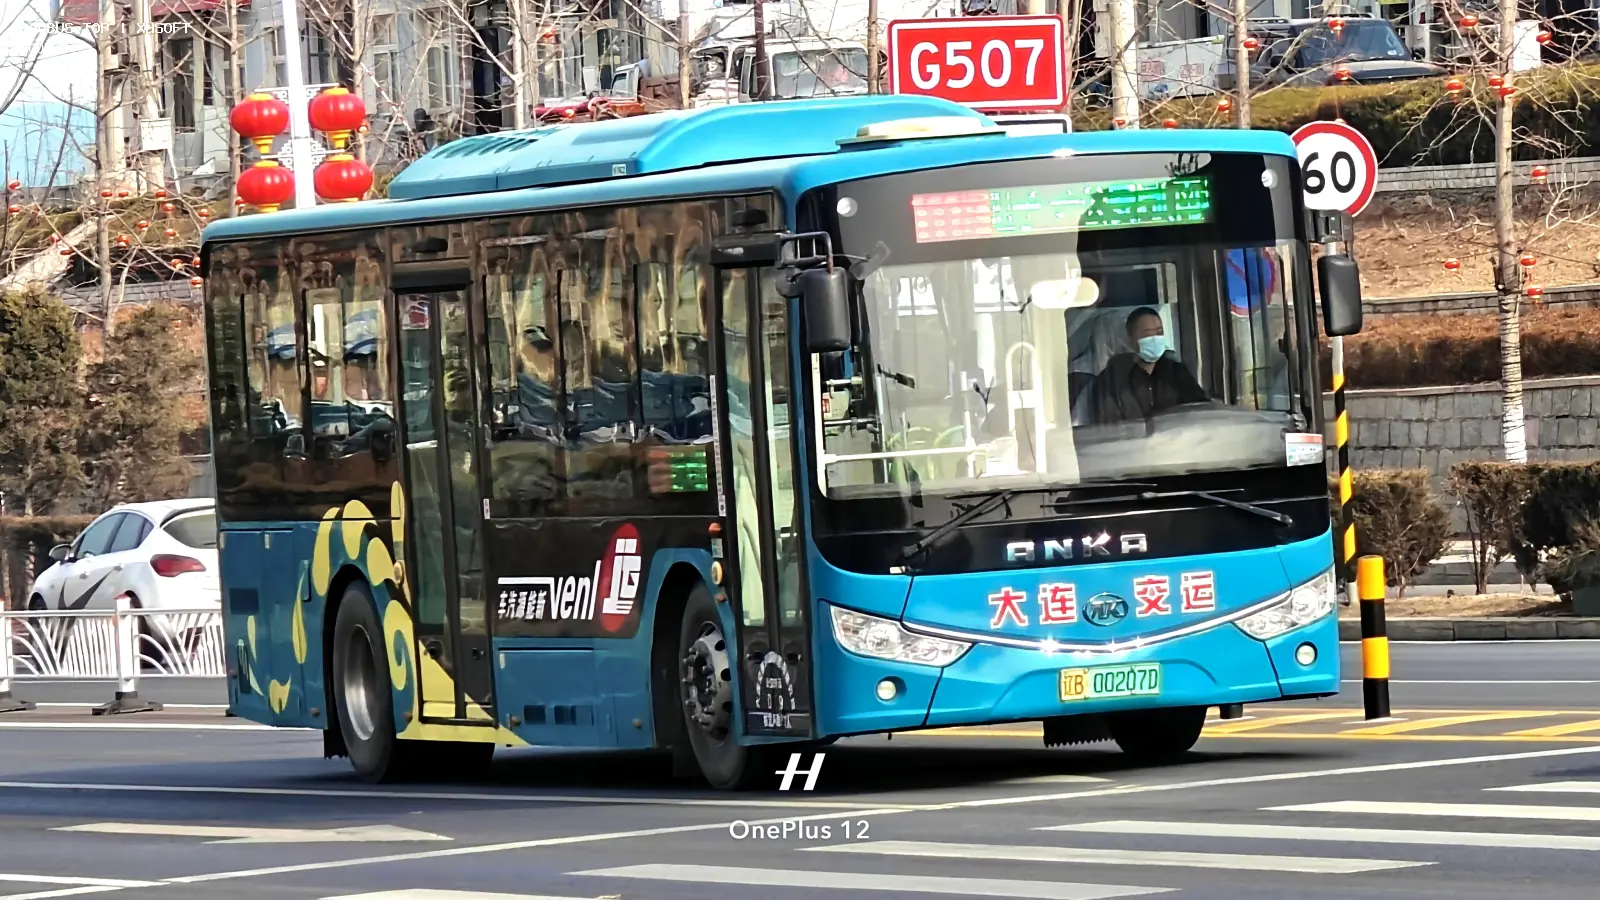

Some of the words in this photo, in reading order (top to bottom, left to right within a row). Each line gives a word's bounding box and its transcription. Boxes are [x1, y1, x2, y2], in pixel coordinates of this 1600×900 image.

[910, 38, 1044, 90] G507
[1302, 150, 1356, 194] 60
[1006, 531, 1148, 562] ANKA
[988, 583, 1078, 629] 大连
[1133, 570, 1216, 618] 交运
